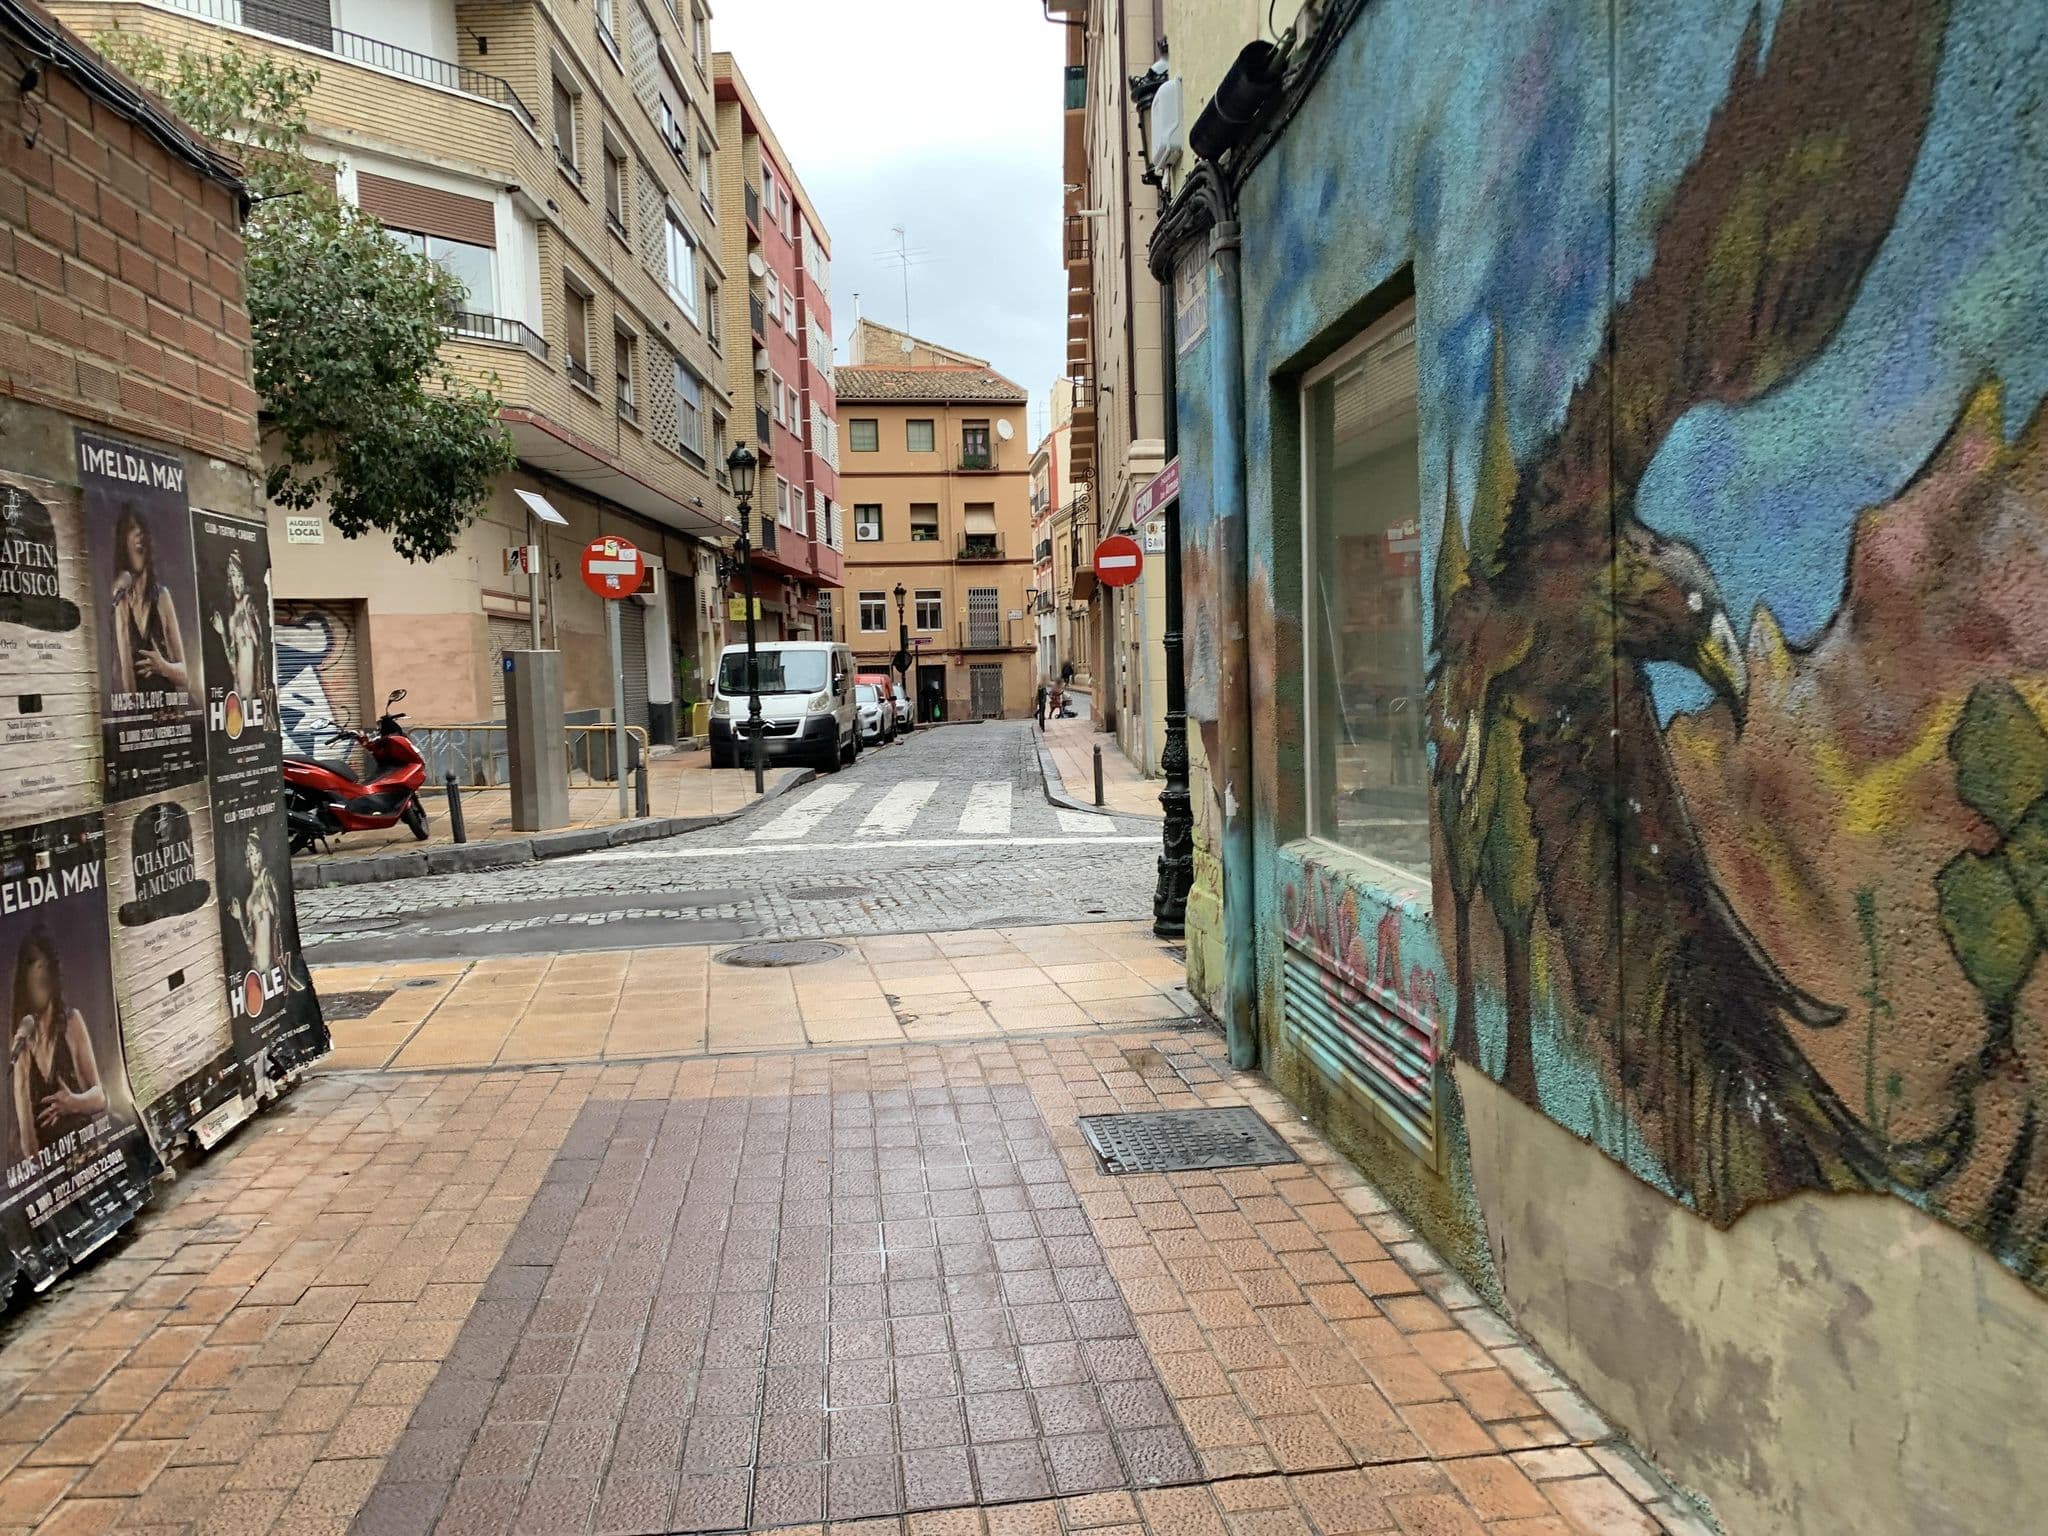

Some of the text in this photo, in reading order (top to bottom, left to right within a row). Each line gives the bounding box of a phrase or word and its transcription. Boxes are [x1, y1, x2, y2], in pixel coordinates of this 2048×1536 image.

[82, 443, 183, 492] IMELDA MAY
[289, 528, 321, 537] LOCAL
[210, 686, 223, 699] THE
[61, 860, 100, 896] MAY
[137, 863, 194, 902] el MÚSICO
[229, 970, 243, 986] THE
[38, 1147, 52, 1171] TO
[53, 1131, 78, 1161] LOVE
